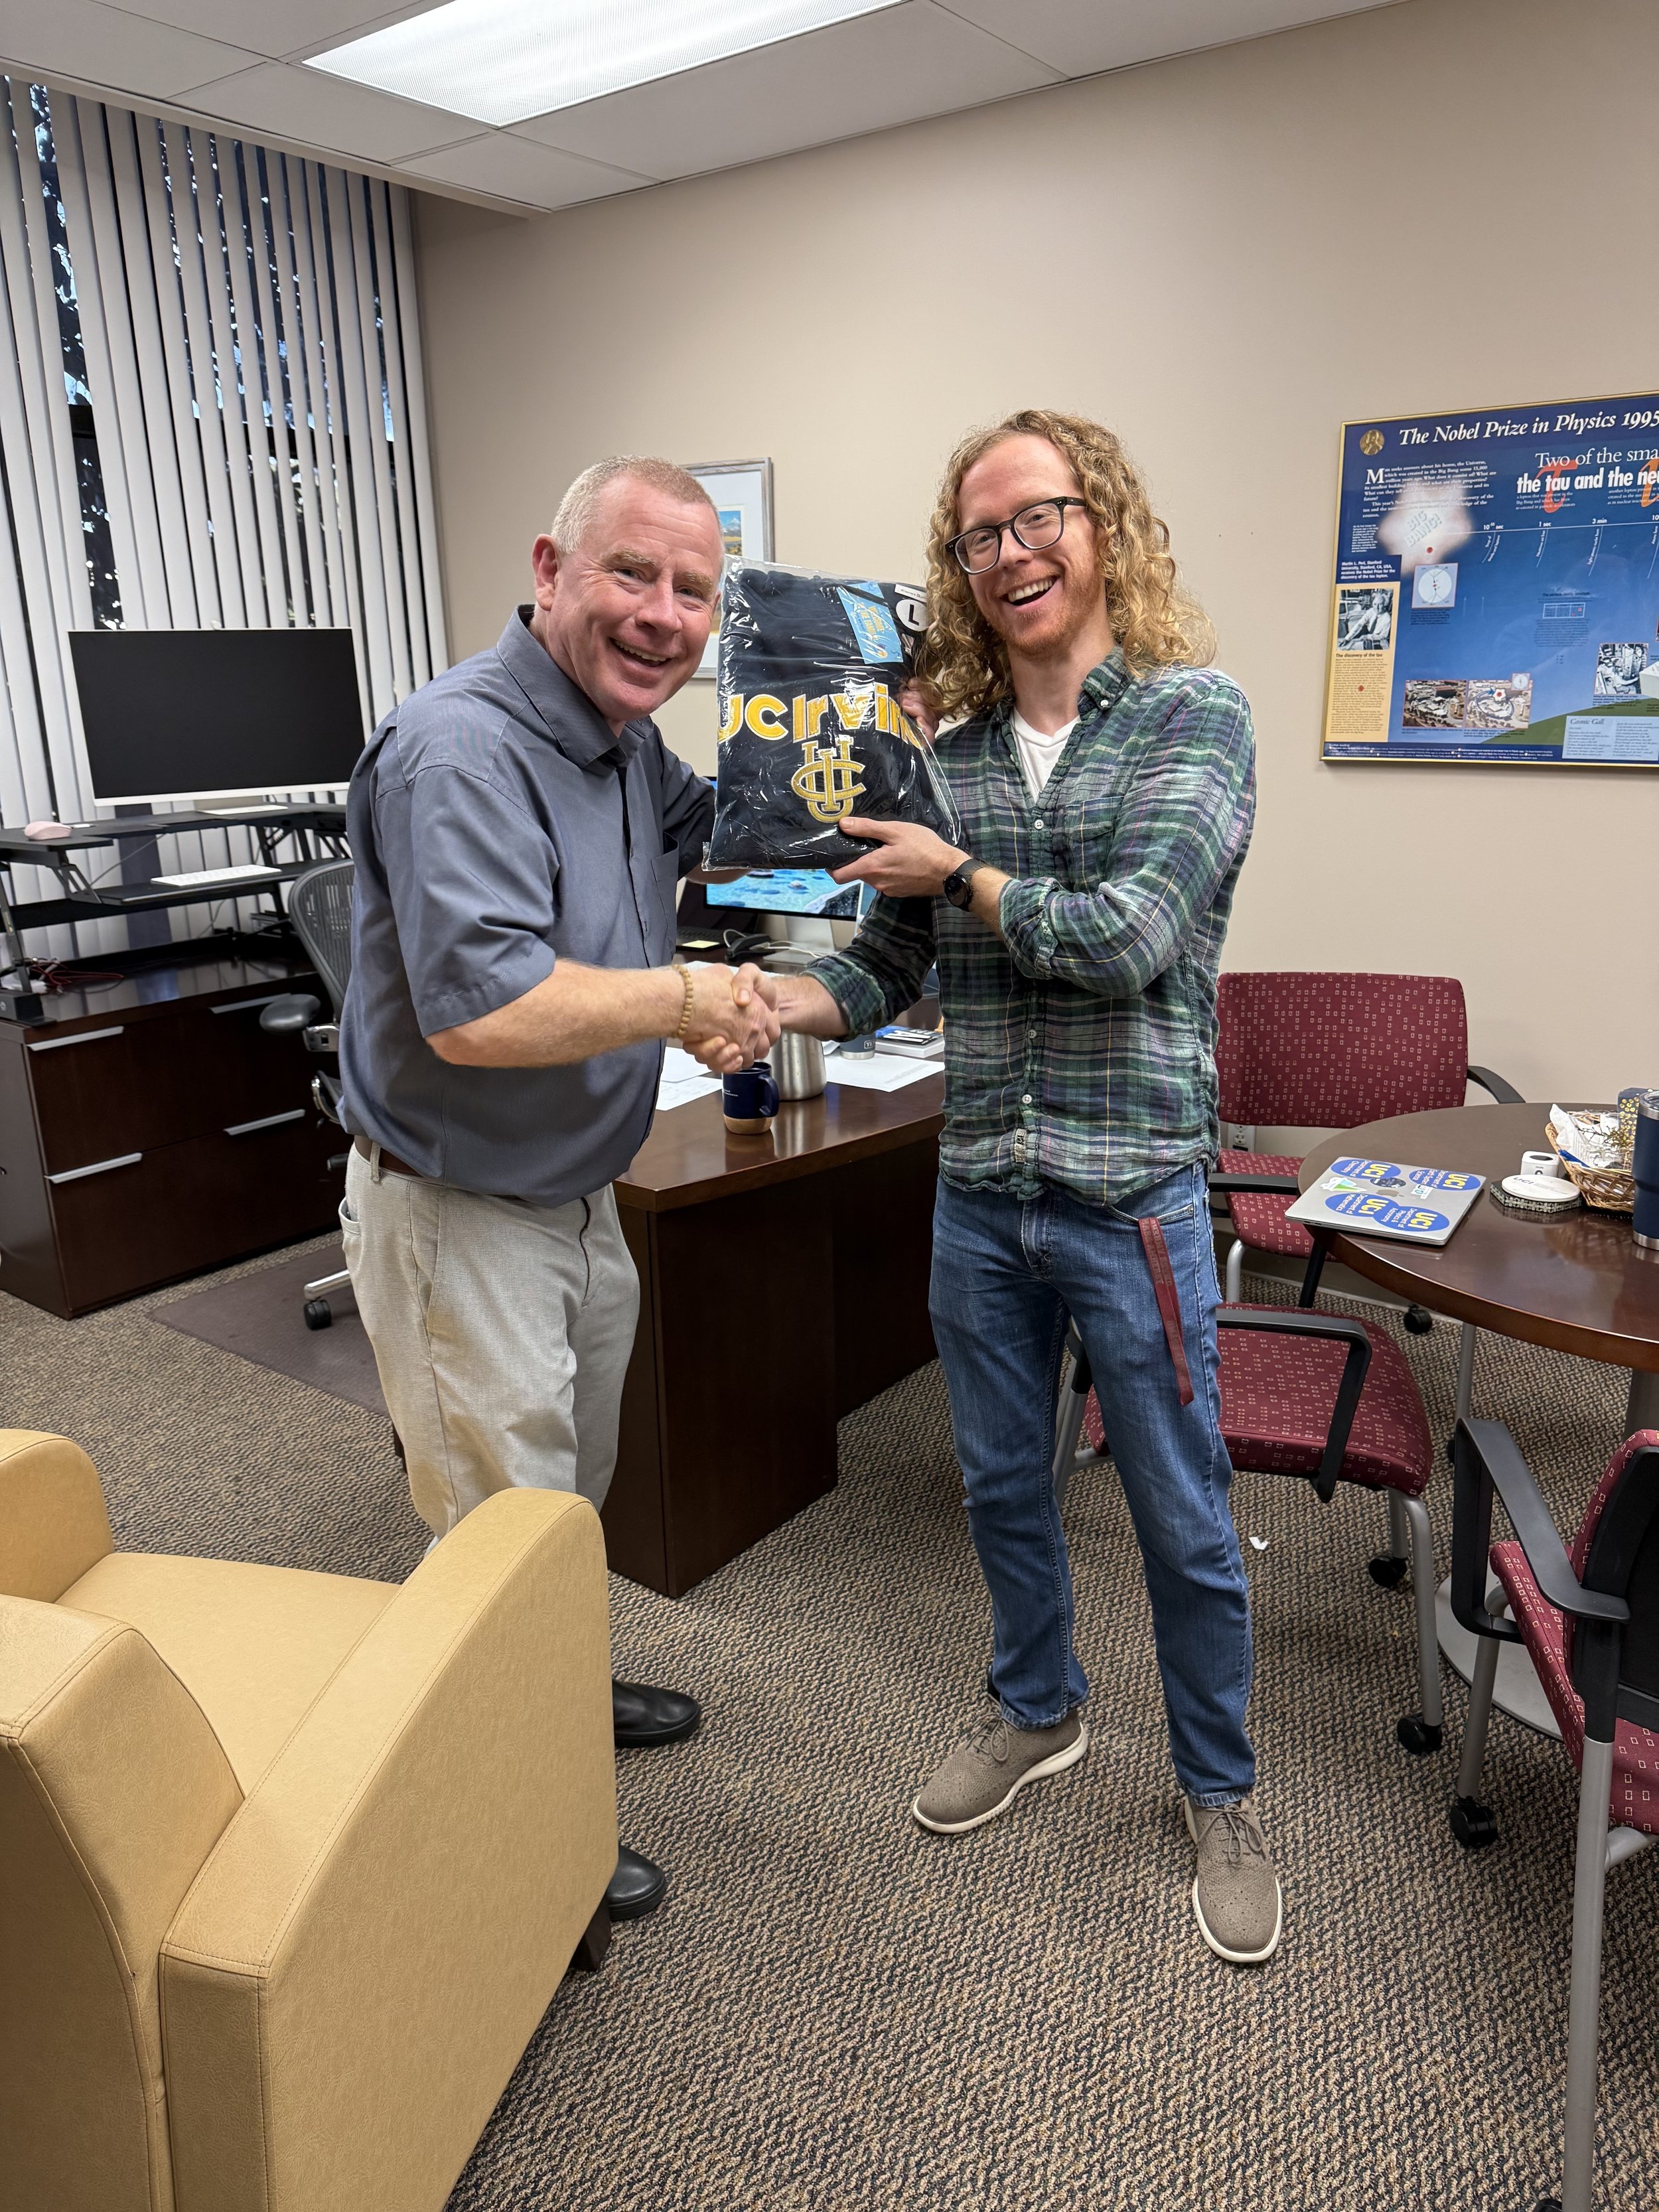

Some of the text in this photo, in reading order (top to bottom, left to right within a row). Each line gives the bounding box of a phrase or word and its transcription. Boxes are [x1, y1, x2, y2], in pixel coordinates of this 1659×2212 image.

[1400, 409, 1659, 445] The Nobel Prize in Physics 1995
[1535, 452, 1570, 469] Two
[1575, 448, 1595, 465] of
[1597, 447, 1622, 463] the
[1516, 473, 1541, 494] the
[1546, 475, 1571, 492] tau
[1574, 467, 1605, 490] and
[1607, 466, 1633, 488] the
[908, 603, 920, 626] L
[1361, 1163, 1391, 1178] UCI
[1443, 1173, 1469, 1189] UCI
[1358, 1199, 1389, 1215] UCI
[1407, 1212, 1437, 1230] UCI
